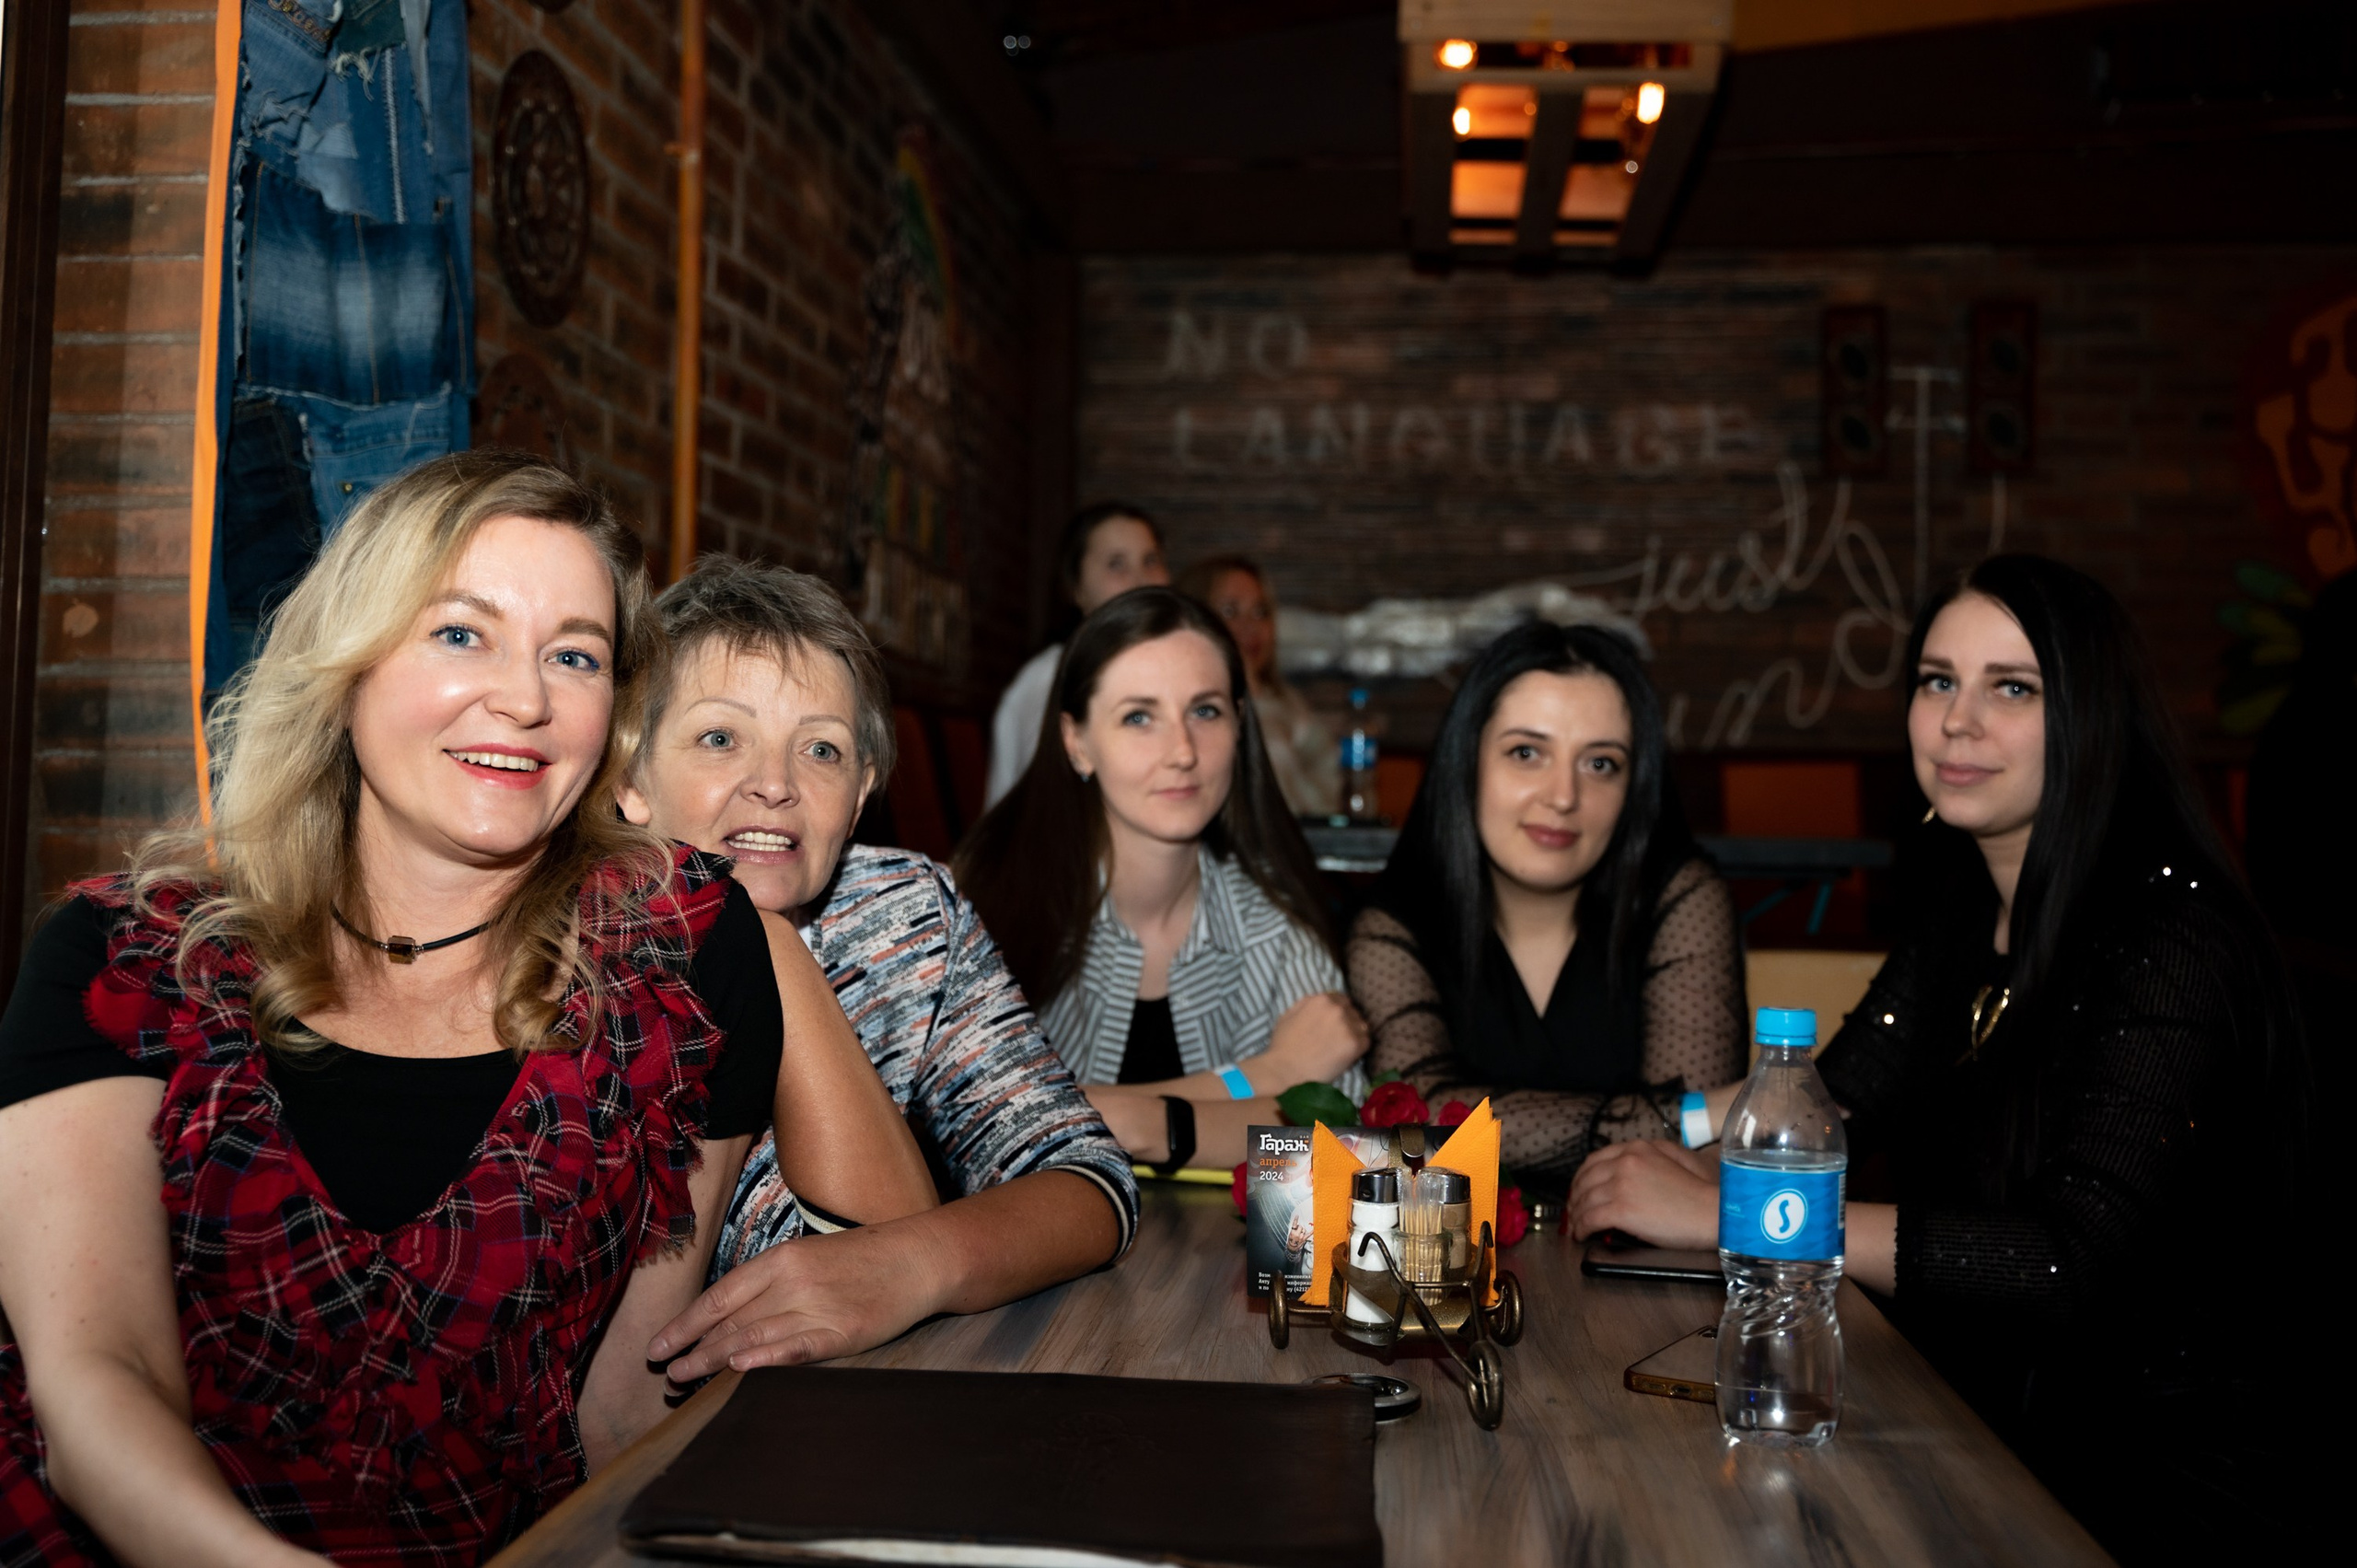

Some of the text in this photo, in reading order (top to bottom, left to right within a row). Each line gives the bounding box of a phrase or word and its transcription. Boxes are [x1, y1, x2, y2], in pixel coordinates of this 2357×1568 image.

[1164, 308, 1310, 380] NO
[1172, 401, 1752, 476] LANGUAGE
[1260, 1132, 1309, 1156] Гараж
[1260, 1157, 1297, 1169] апрель
[1260, 1170, 1284, 1181] 2024
